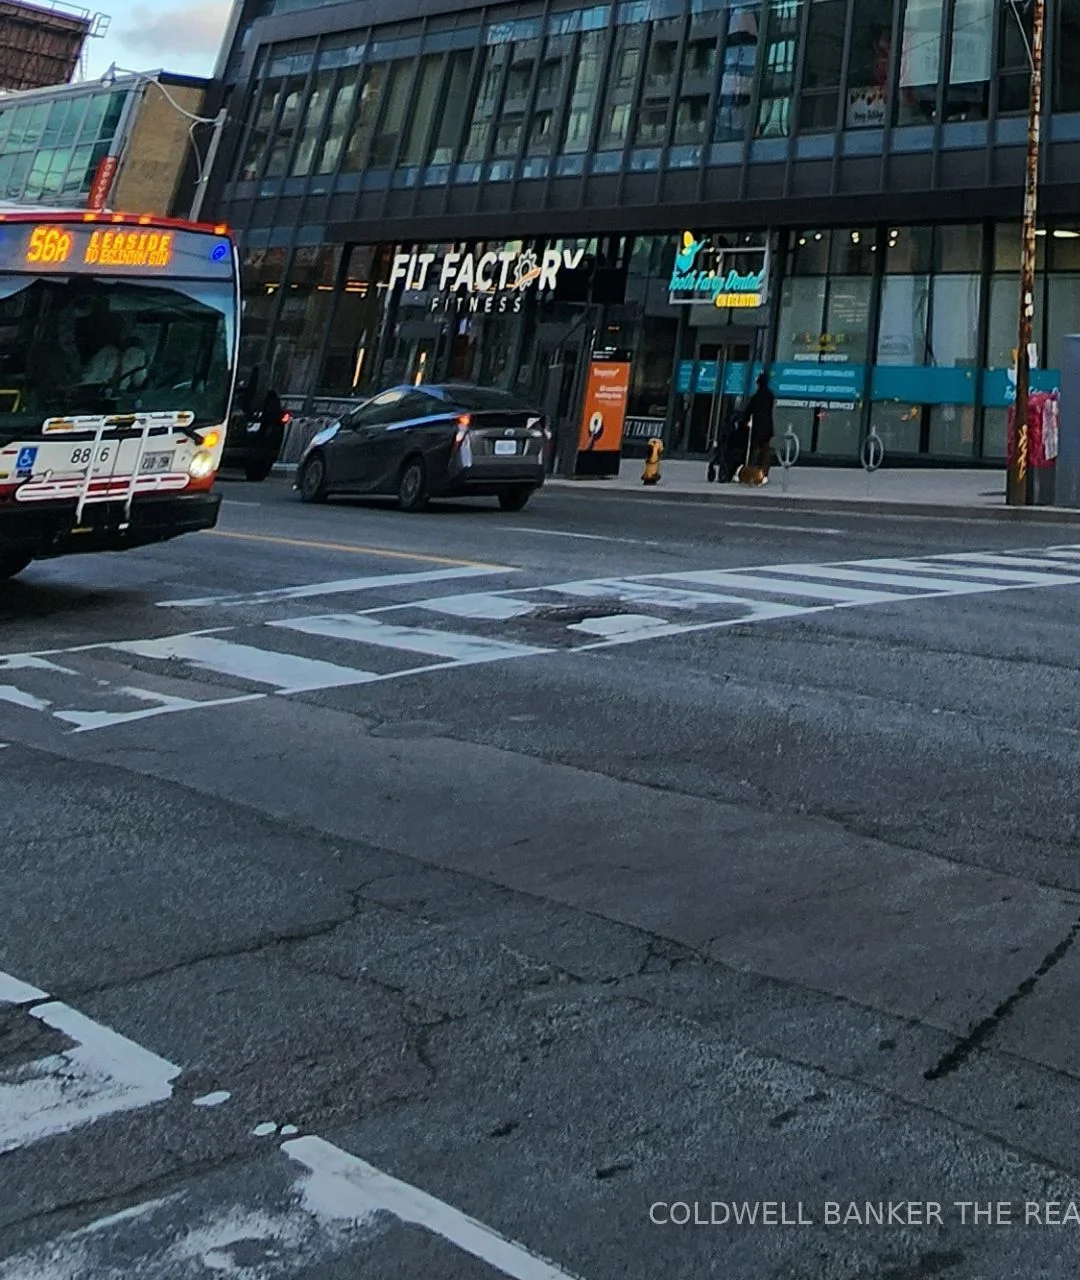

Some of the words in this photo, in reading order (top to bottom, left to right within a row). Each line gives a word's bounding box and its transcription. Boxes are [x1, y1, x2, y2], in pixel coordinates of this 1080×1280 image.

[27, 225, 72, 263] 56A
[90, 230, 172, 251] LEASIDE
[388, 253, 435, 291] FIT
[431, 296, 522, 313] FITNESS
